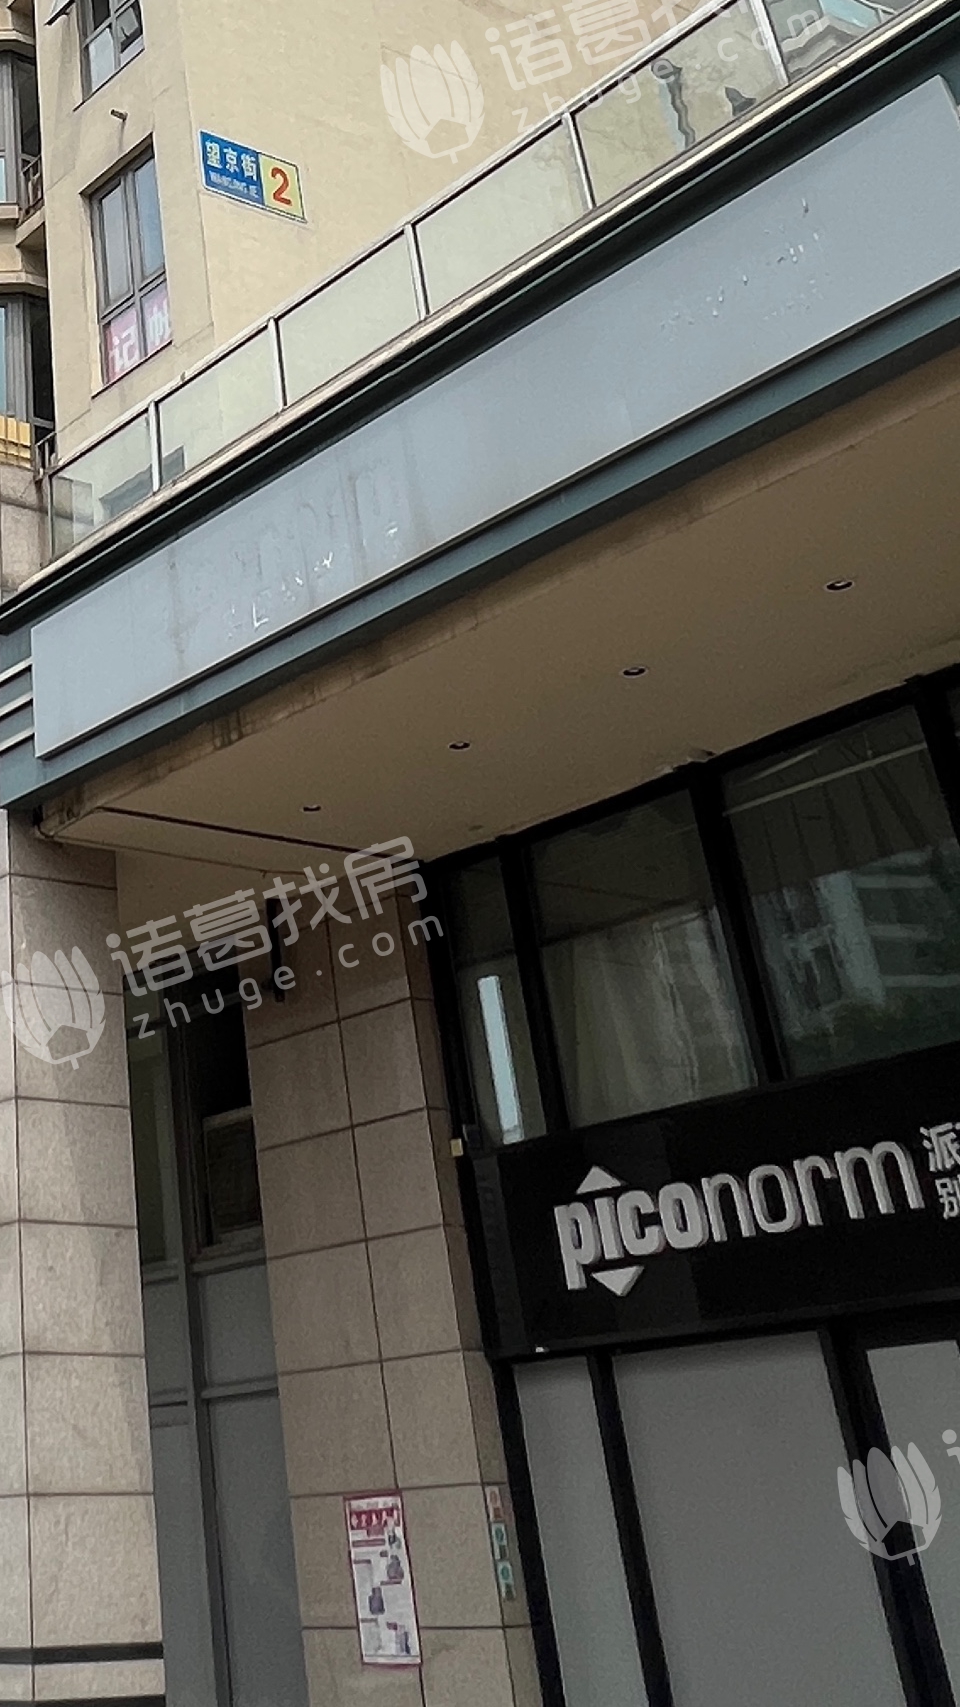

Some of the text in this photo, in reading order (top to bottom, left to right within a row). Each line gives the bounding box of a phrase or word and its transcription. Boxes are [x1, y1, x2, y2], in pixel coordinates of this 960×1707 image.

[206, 140, 293, 206] 望京街 2
[554, 1140, 926, 1290] piconorm
